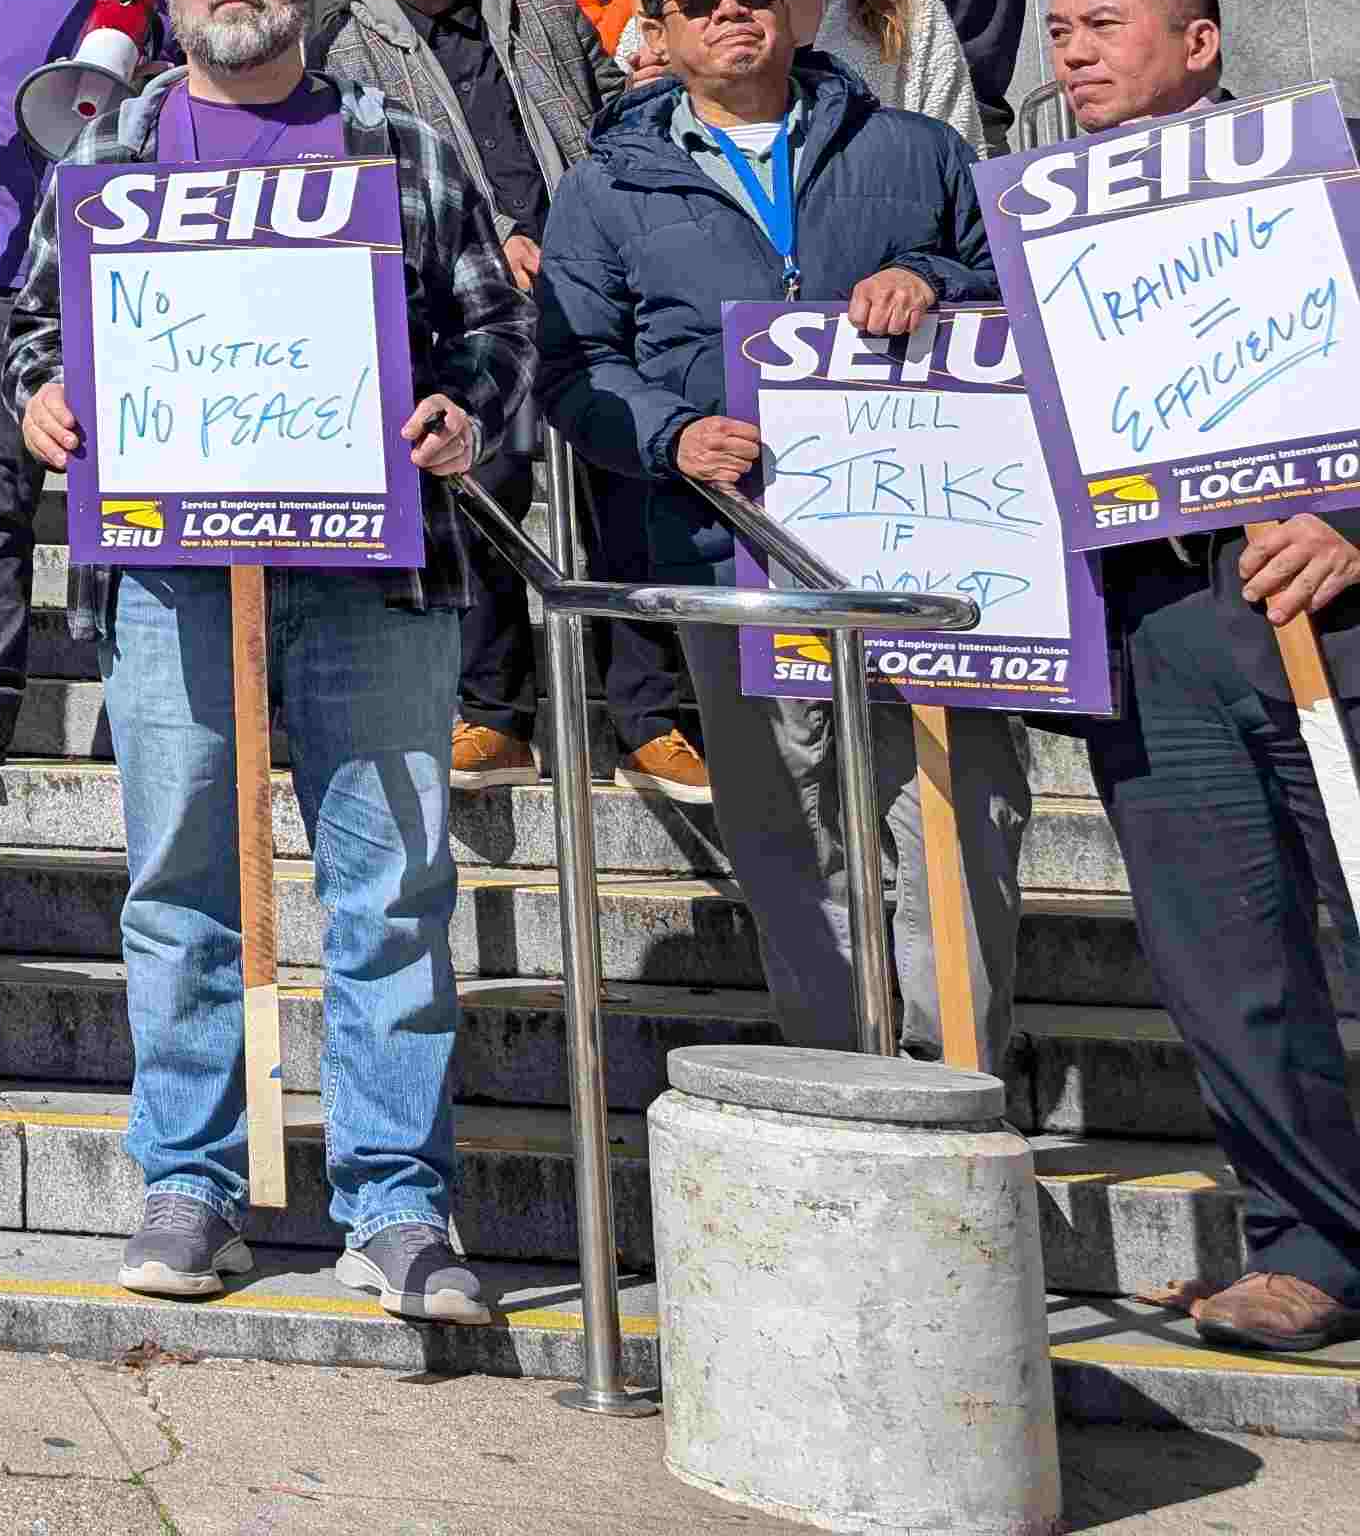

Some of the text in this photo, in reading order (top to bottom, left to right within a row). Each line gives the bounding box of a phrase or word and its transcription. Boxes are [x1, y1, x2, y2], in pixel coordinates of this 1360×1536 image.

[1020, 97, 1295, 232] SEIU
[92, 165, 360, 246] SEIU
[1042, 207, 1295, 342] TRAINING
[148, 312, 311, 373] JUSTICE
[760, 312, 1023, 383] SEIU
[1110, 277, 1336, 453] EFFICIENCY
[118, 366, 370, 458] NO PEACE!
[844, 393, 960, 435] WILL
[769, 434, 1046, 527] STRIKE
[1171, 462, 1213, 478] Service
[1213, 452, 1277, 471] Employees
[1180, 462, 1305, 504] LOCAL
[1316, 452, 1360, 483] 10
[181, 500, 385, 512] Service Employees International Union
[182, 513, 385, 538] LOCAL 1021
[1094, 501, 1160, 529] SEIU
[100, 527, 164, 547] SEIU
[881, 523, 916, 552] IF
[897, 639, 1070, 656] Employees International Union
[989, 655, 1070, 683] 1021
